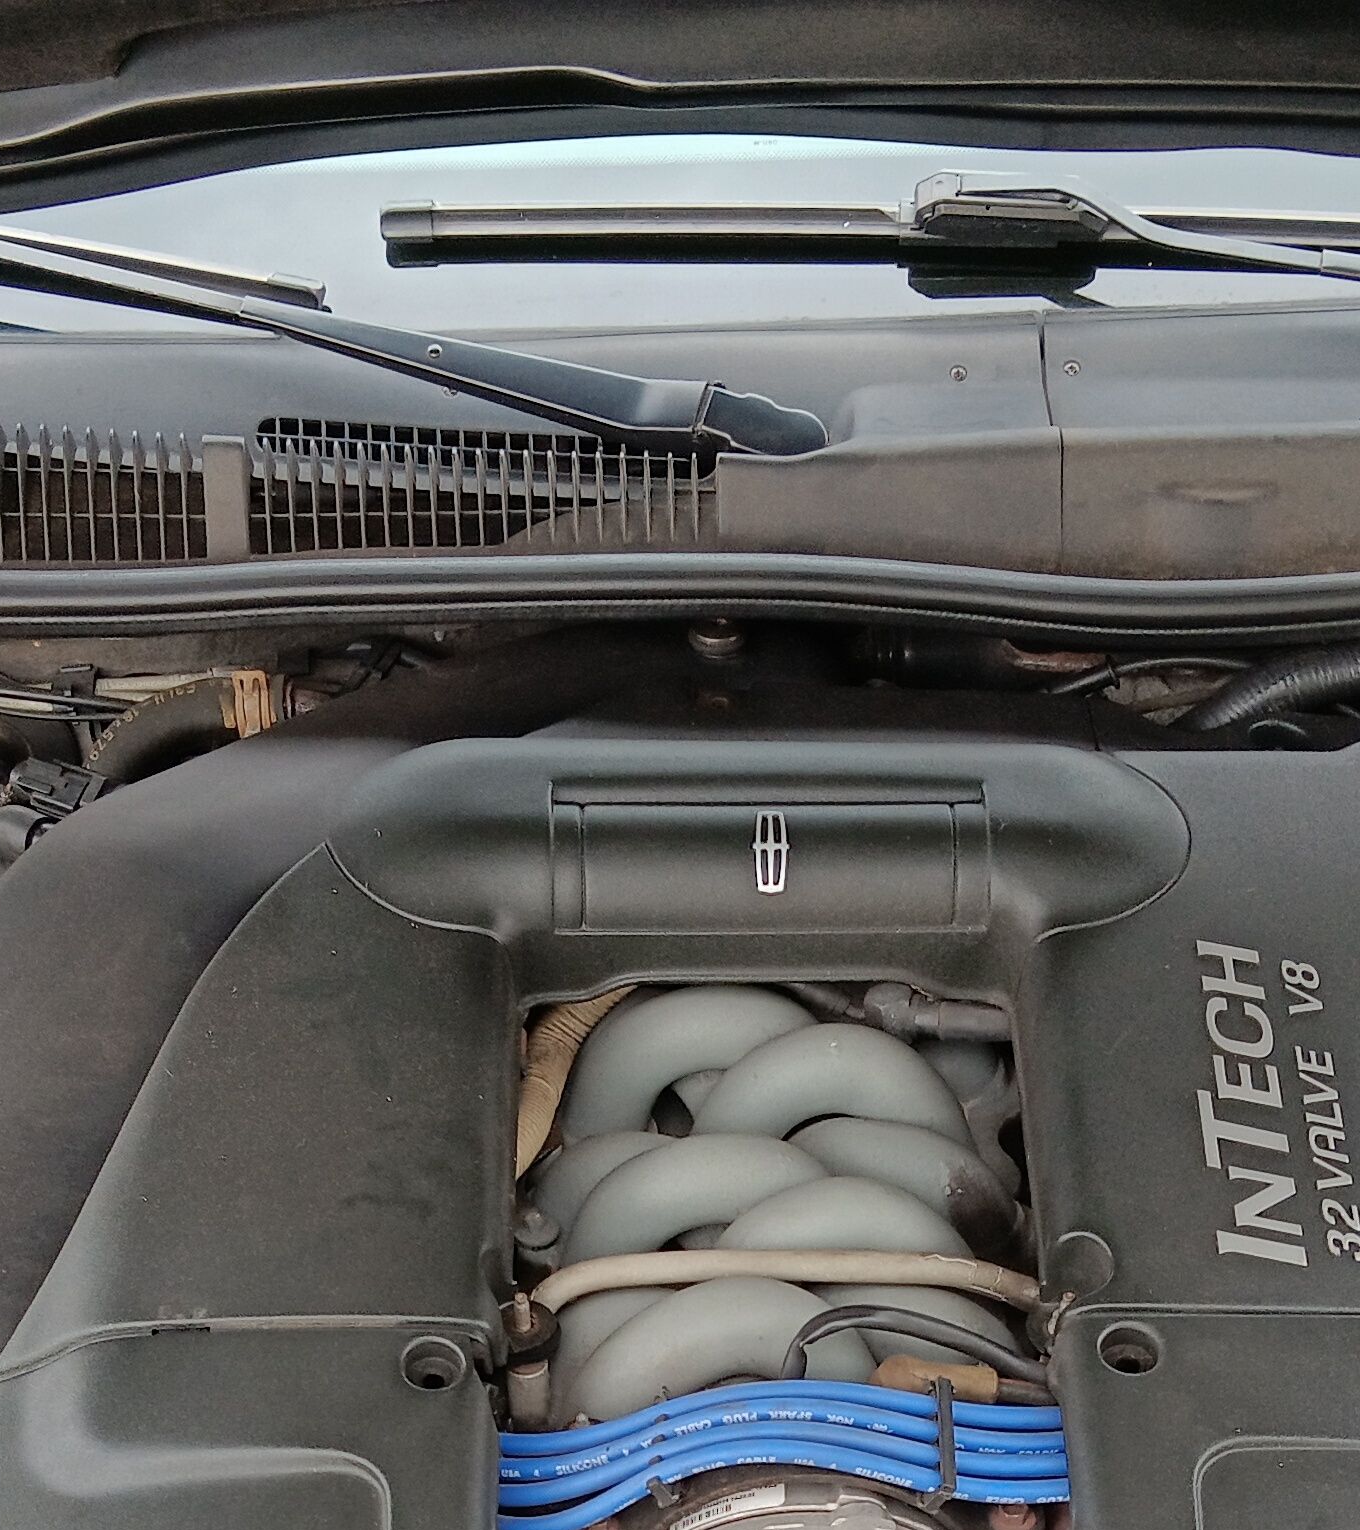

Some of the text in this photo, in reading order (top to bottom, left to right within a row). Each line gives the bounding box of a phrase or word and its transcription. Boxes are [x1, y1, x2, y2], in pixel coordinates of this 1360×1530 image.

[1281, 959, 1324, 1015] V8
[1295, 1045, 1354, 1191] VALVE
[723, 1413, 758, 1425] PLUG
[768, 1411, 813, 1421] SPARK
[674, 1419, 711, 1436] CABLE
[555, 1454, 610, 1477] SILICONE
[854, 1467, 914, 1487] SILICONE
